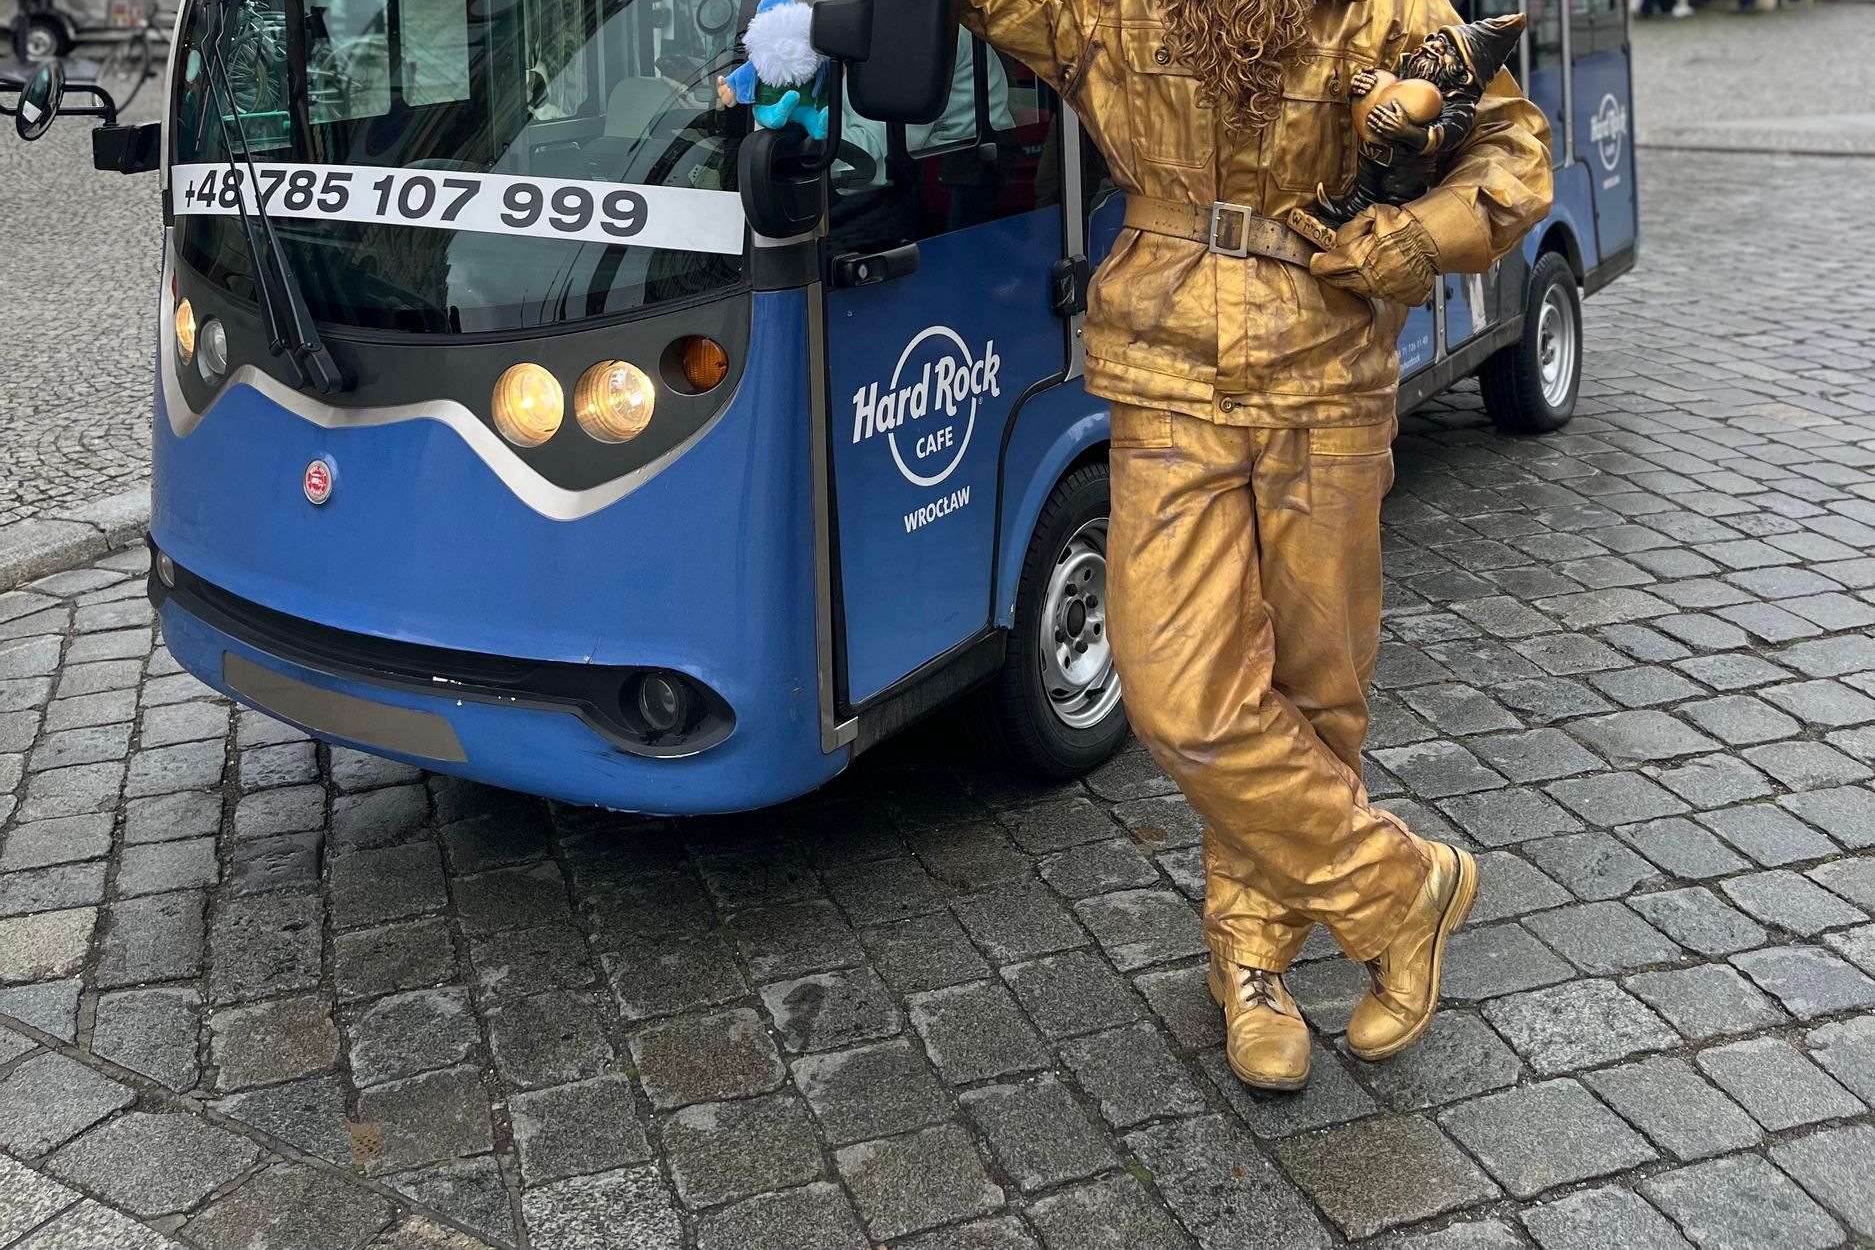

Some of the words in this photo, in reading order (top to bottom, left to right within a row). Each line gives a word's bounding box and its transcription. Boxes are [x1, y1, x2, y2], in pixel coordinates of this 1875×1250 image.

[184, 169, 244, 209] +48
[256, 169, 353, 213] 785
[372, 174, 481, 222] 107
[500, 184, 649, 238] 999
[852, 362, 931, 444] Hard
[935, 339, 1001, 417] Rock
[915, 426, 953, 459] CAFE
[904, 486, 971, 533] WROCŁAW
